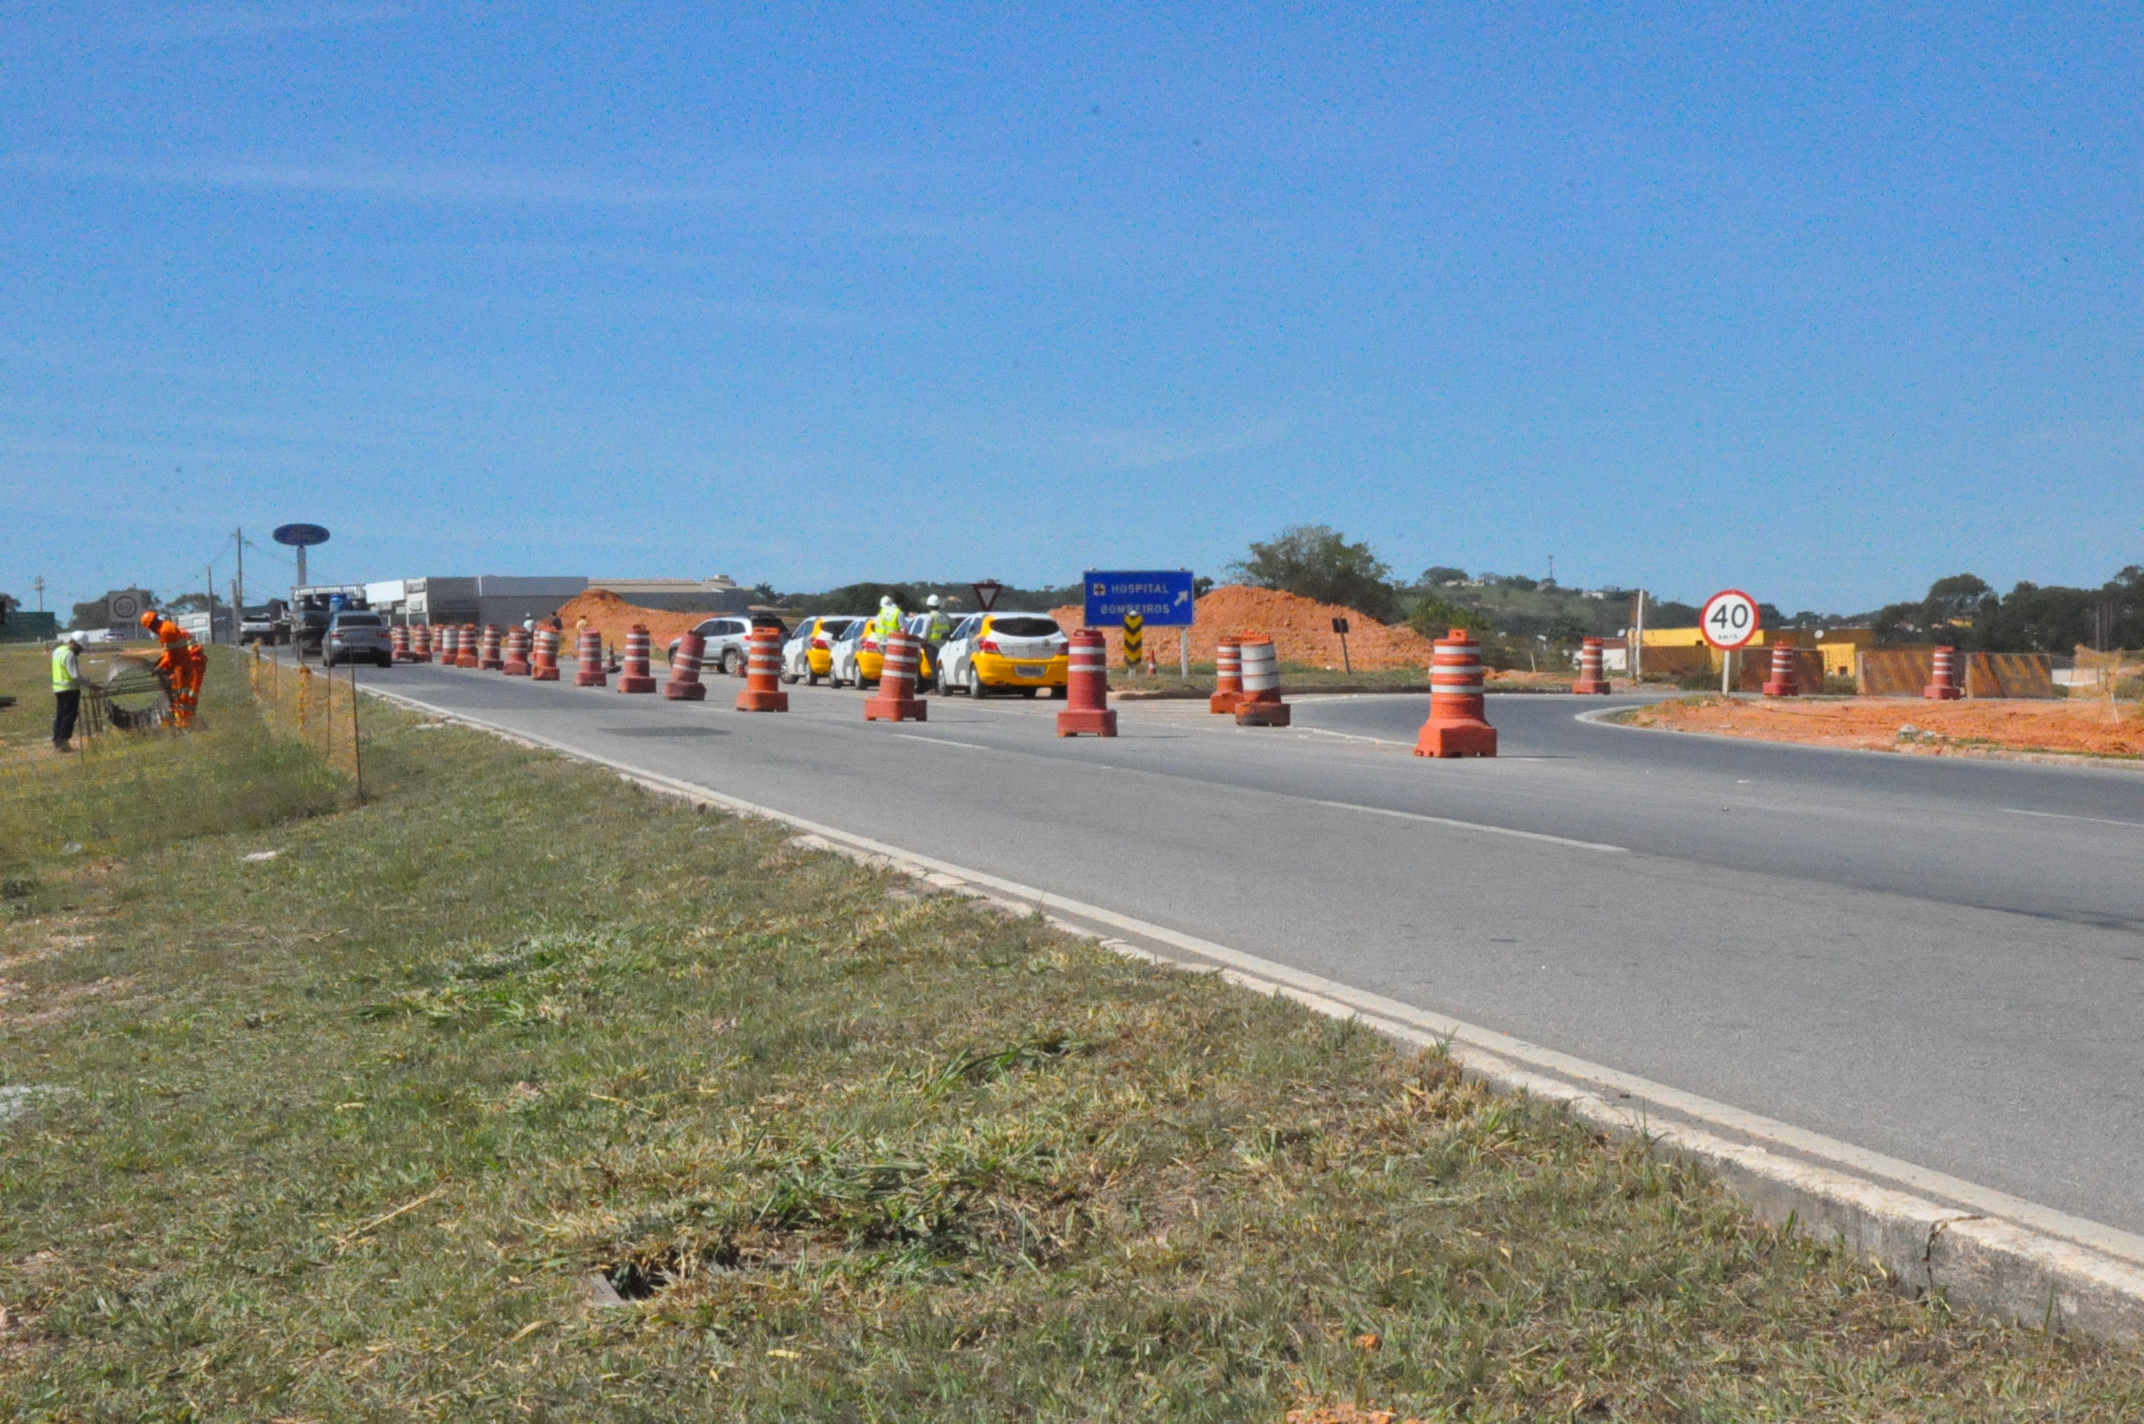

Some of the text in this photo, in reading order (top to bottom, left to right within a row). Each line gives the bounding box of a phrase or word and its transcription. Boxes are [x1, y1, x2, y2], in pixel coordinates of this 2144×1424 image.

[1111, 583, 1170, 594] HOSPITAL
[1100, 604, 1170, 615] BOMBEIROS
[1710, 603, 1749, 629] 40
